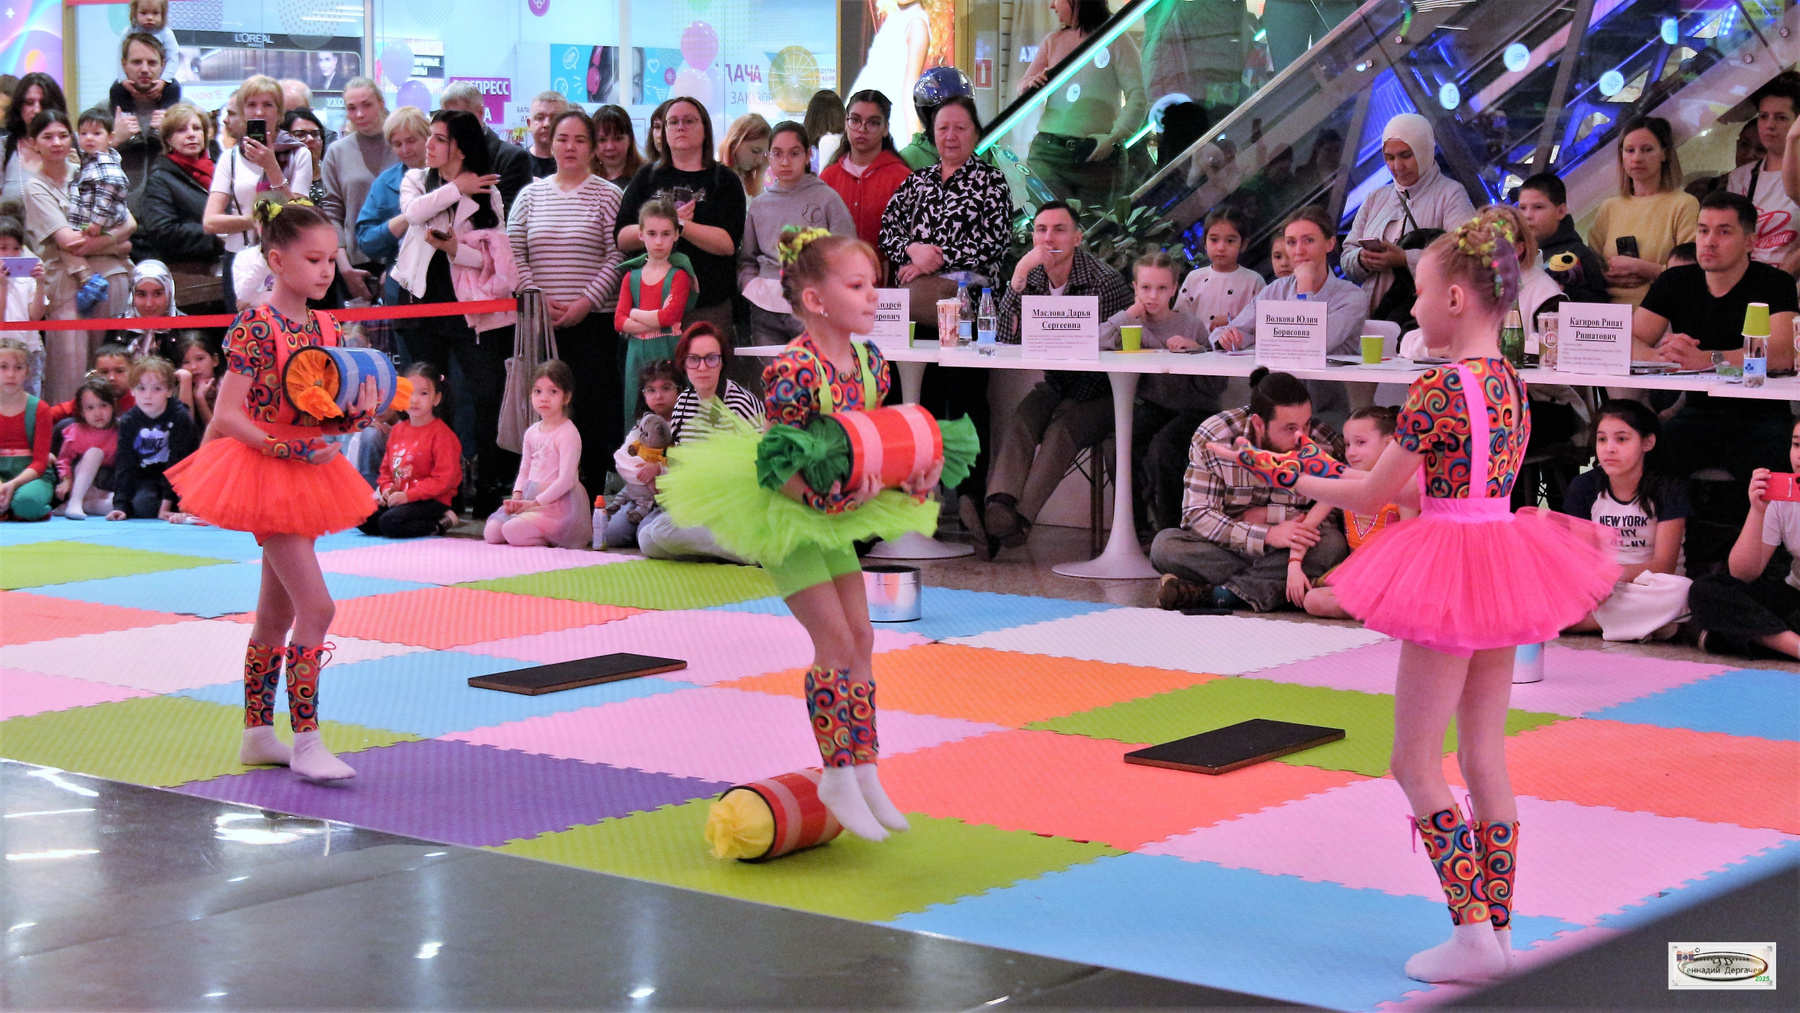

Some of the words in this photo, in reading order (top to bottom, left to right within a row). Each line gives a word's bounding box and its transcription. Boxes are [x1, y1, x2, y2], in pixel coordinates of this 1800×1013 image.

[877, 300, 902, 310] ндрей
[1032, 308, 1065, 317] Маслова
[1067, 308, 1091, 318] Дарья
[1265, 314, 1295, 323] Волкова
[1296, 315, 1318, 324] Юлия
[1569, 317, 1600, 328] Кагиров
[1601, 318, 1623, 328] Ринат
[1042, 320, 1081, 330] Сергеевна
[1273, 327, 1310, 337] Борисовна
[1575, 330, 1617, 341] Ришатович
[141, 437, 165, 451] NIKE
[1599, 515, 1621, 527] NEW
[1622, 515, 1649, 527] YORK
